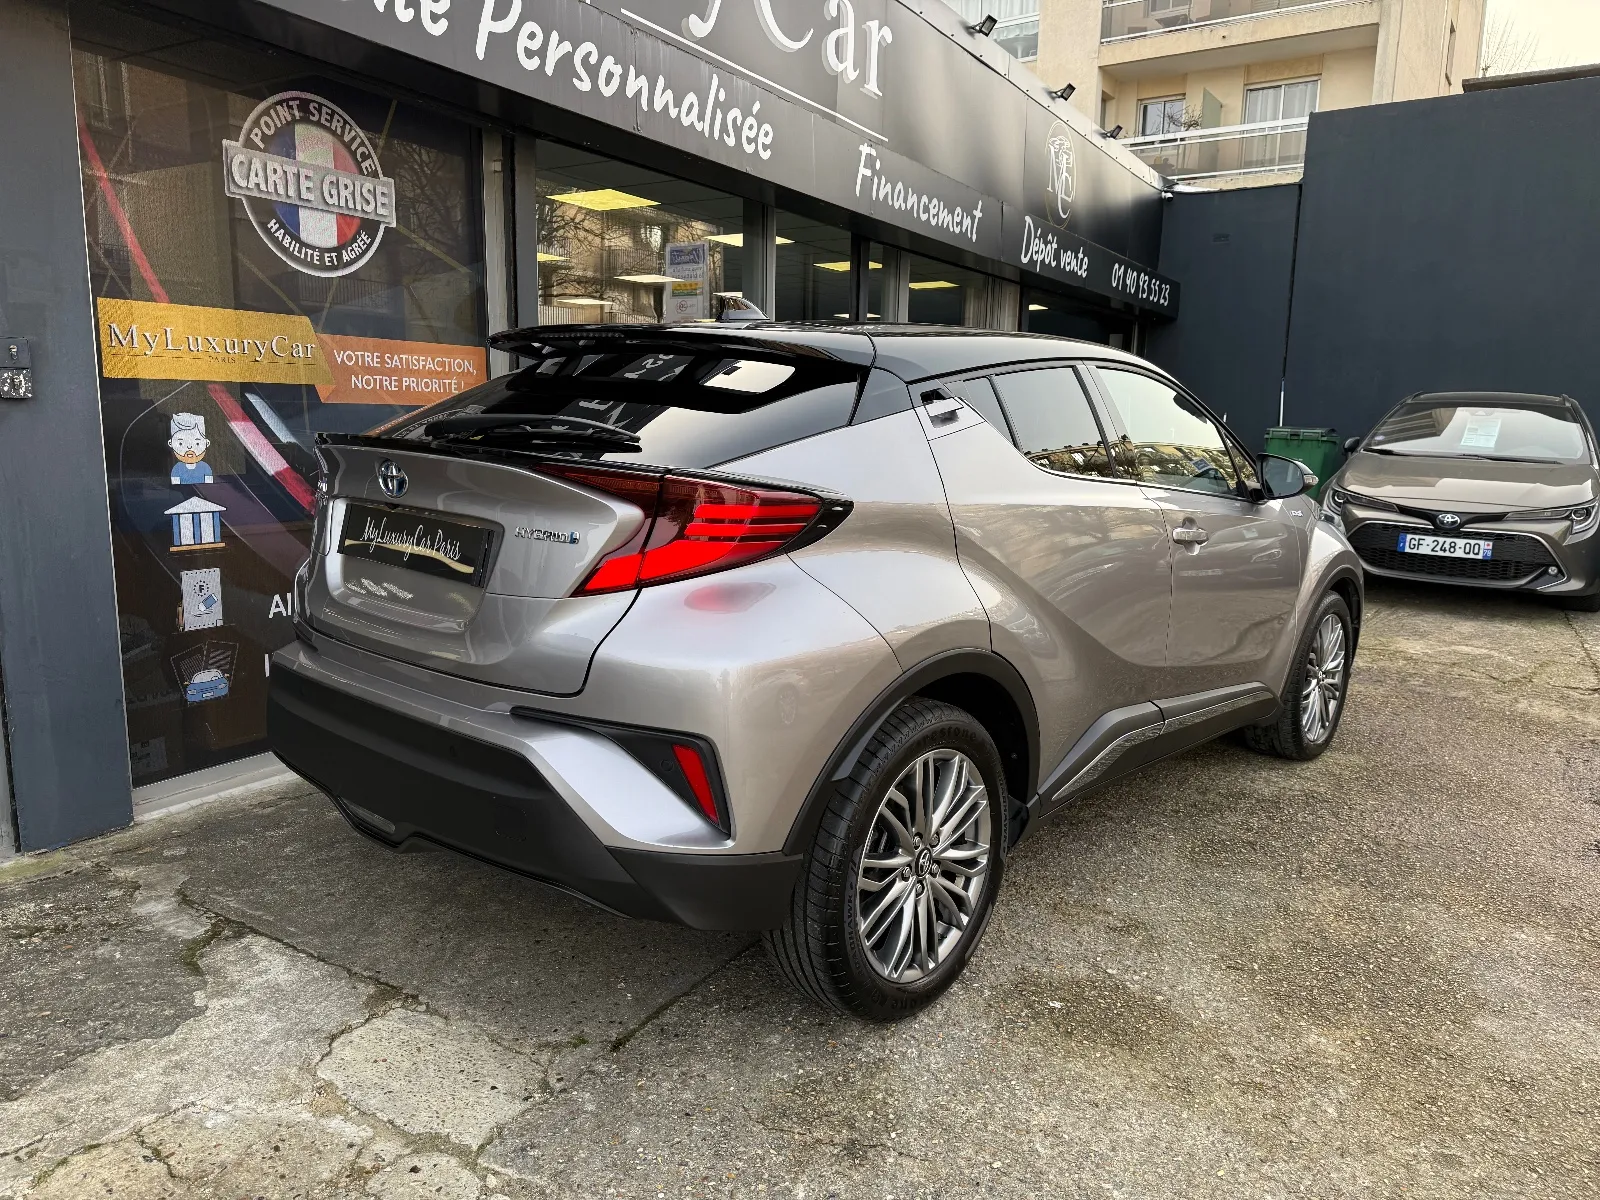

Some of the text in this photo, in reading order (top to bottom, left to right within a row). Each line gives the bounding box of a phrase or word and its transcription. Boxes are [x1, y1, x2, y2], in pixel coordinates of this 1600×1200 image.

[474, 0, 775, 161] Personnalisée
[250, 100, 375, 176] POINT SERVICE
[231, 153, 390, 216] CARTE GRISE
[855, 143, 983, 242] Financement
[267, 218, 320, 264] HABILITÉ
[324, 253, 338, 266] ET
[1020, 215, 1089, 278] Dépôt vente
[1111, 263, 1170, 306] 01 40 93 55 23
[107, 323, 316, 361] MyLuxuryCar
[208, 355, 236, 364] PARIS
[333, 350, 477, 375] VOTRE SATISFACTION,
[351, 374, 399, 391] NOTRE
[402, 377, 460, 394] PRIORITÉ
[514, 526, 570, 544] HYBRID
[1408, 537, 1481, 556] GF-248-QQ
[1483, 549, 1492, 557] 78
